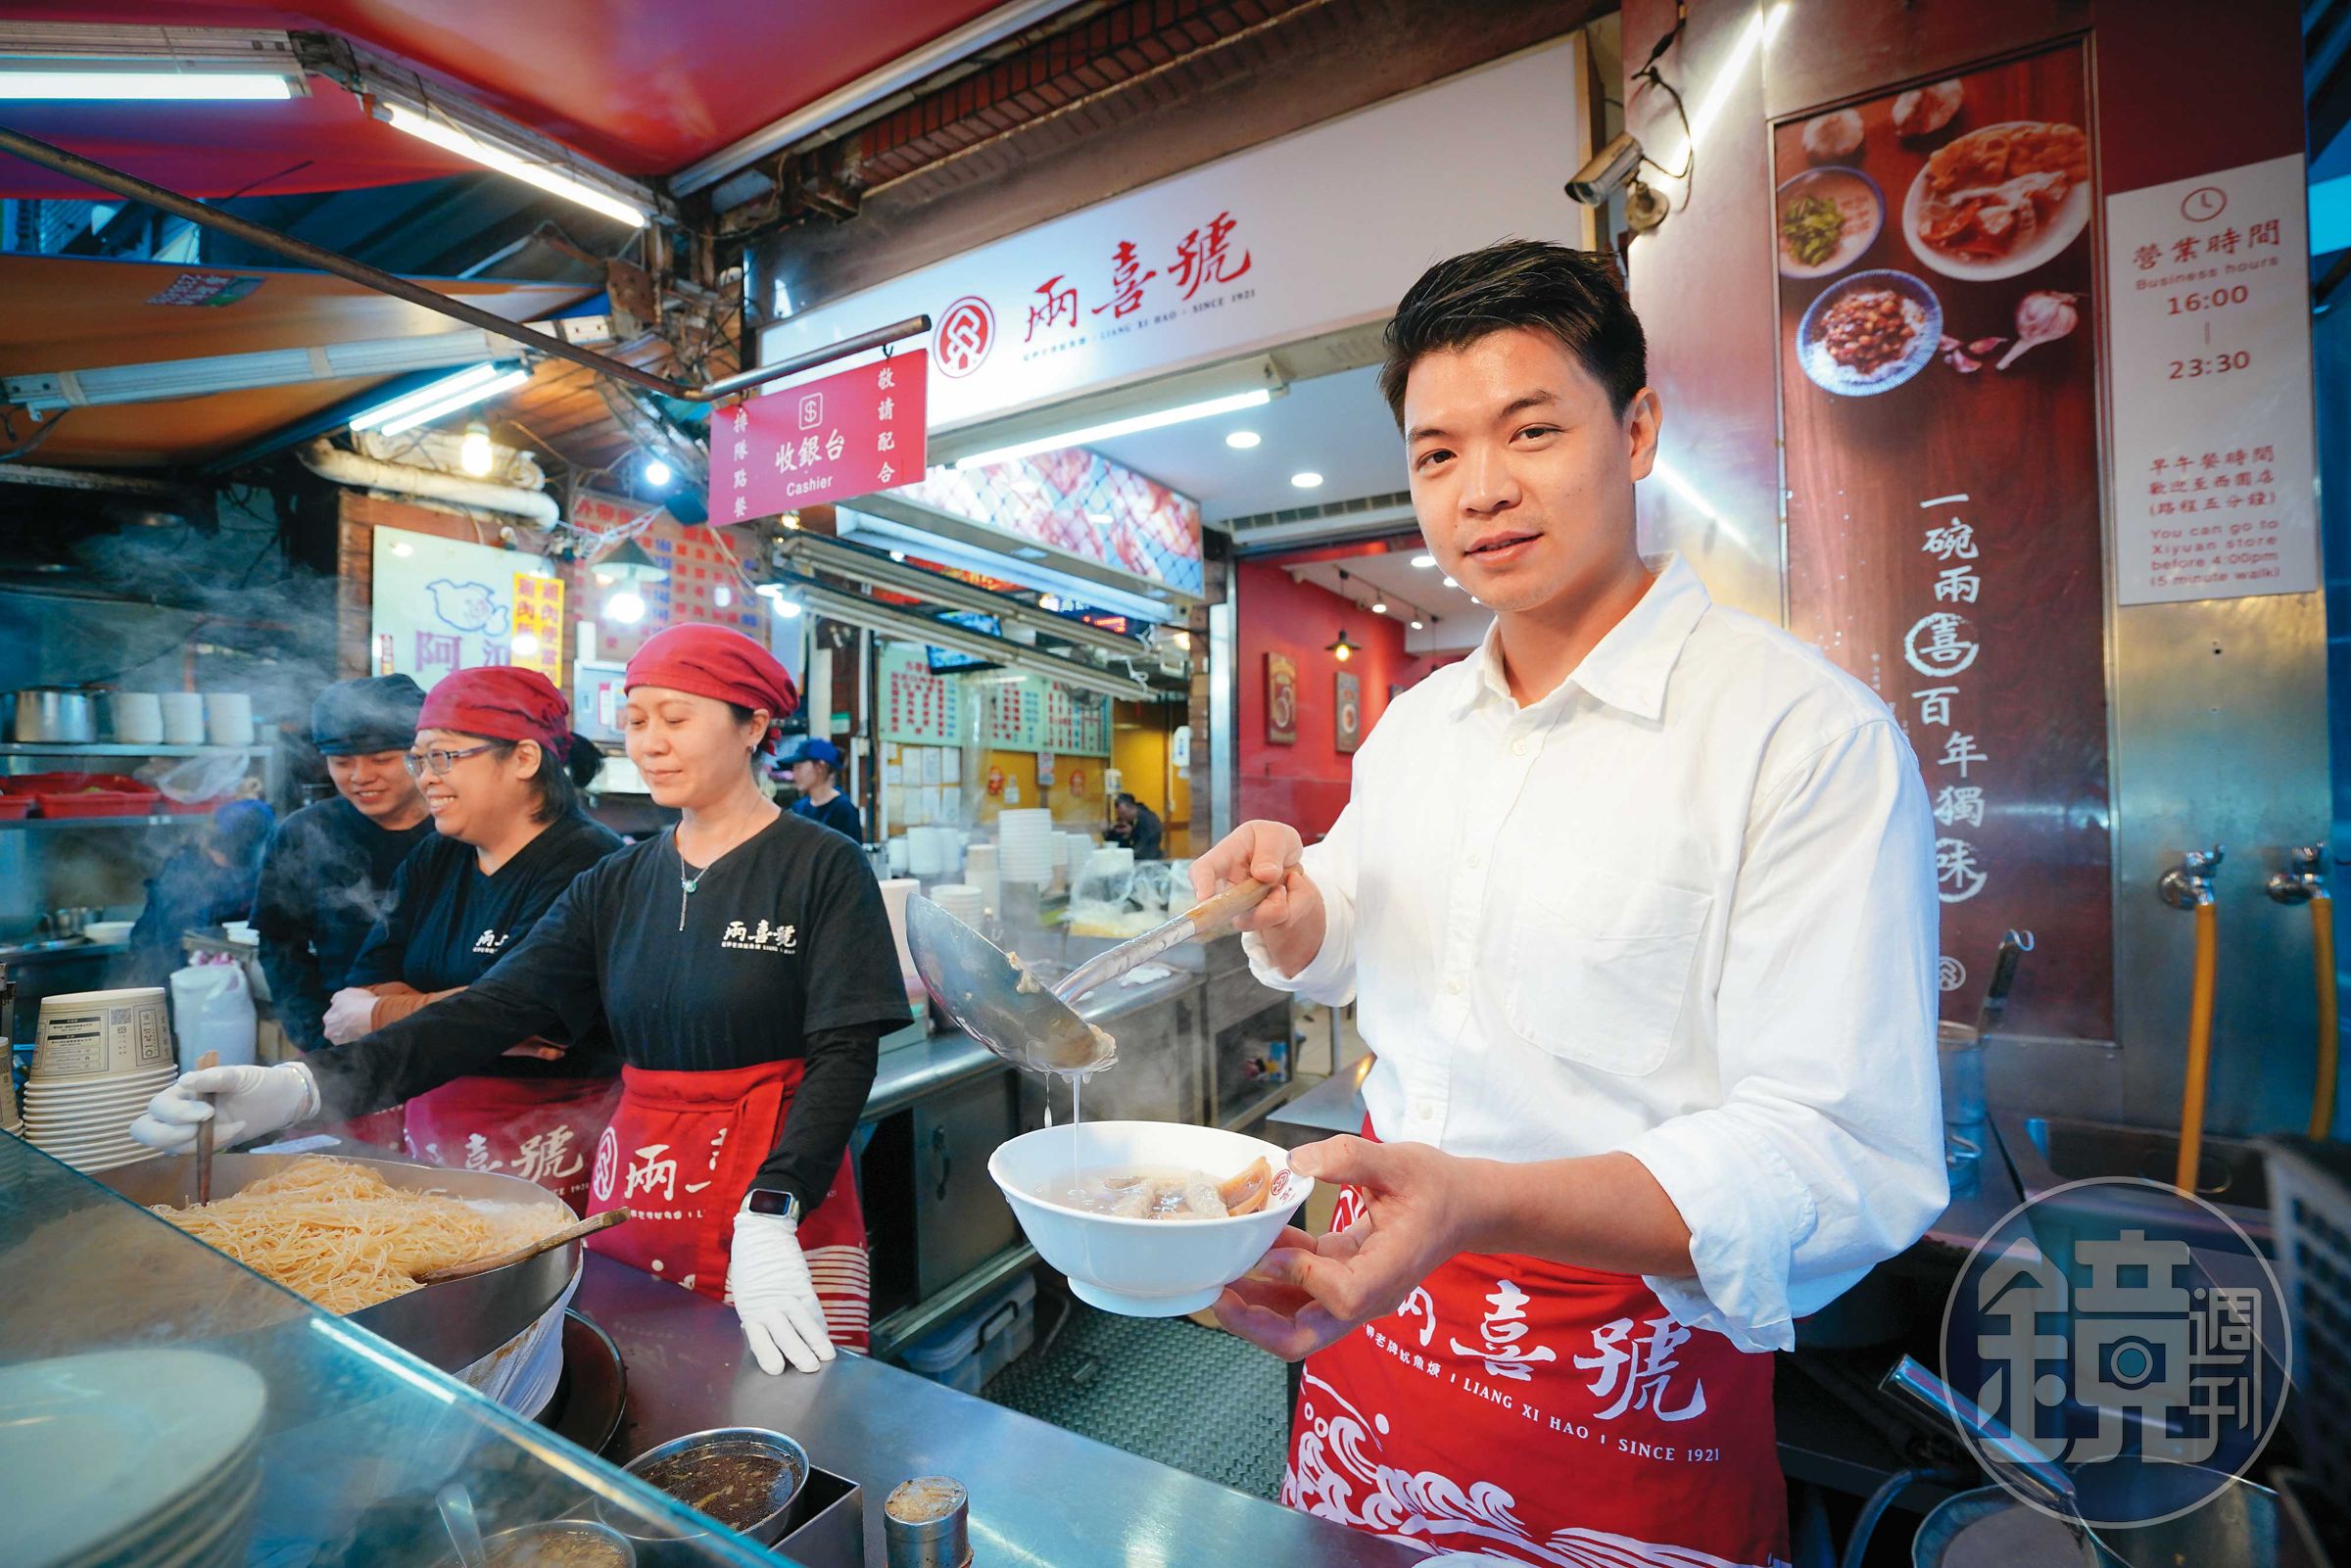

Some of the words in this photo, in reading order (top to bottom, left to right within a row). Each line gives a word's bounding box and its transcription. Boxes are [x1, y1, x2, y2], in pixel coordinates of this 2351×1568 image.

[2133, 218, 2280, 270] 營業時間
[1025, 211, 1252, 343] 兩喜號
[2135, 267, 2218, 291] Business
[2224, 256, 2279, 274] hours
[1192, 297, 1223, 313] SINCE
[2167, 284, 2249, 315] 16:00
[2168, 350, 2251, 380] 23:30
[877, 367, 895, 484] 敬請配合
[734, 408, 748, 518] 排隊點餐
[775, 428, 845, 474] 收銀台
[786, 475, 833, 497] Cashier
[2150, 528, 2183, 539] You
[2189, 526, 2223, 537] can
[2230, 522, 2253, 536] go
[2259, 520, 2279, 530] to
[2226, 537, 2278, 549] store
[2151, 558, 2205, 571] before
[475, 929, 509, 947] 兩
[1463, 1377, 1513, 1408] LIANG
[1521, 1403, 1540, 1422] XI
[1549, 1415, 1589, 1439] HAO
[1617, 1438, 1676, 1461] SINCE
[1687, 1448, 1720, 1462] 1921
